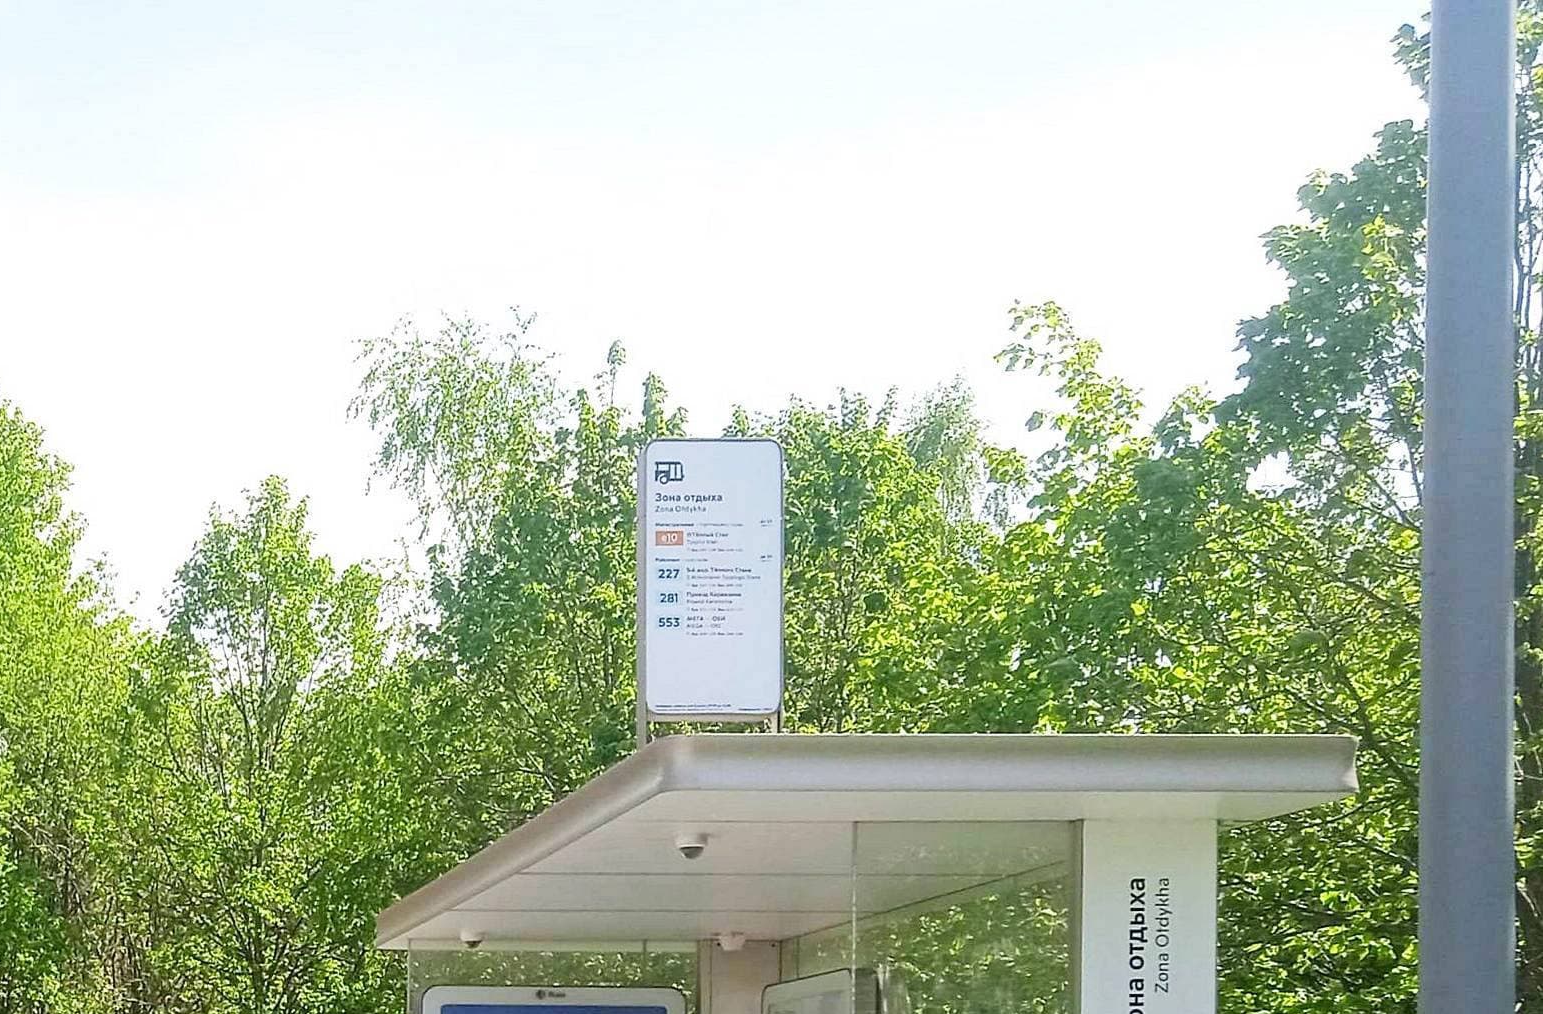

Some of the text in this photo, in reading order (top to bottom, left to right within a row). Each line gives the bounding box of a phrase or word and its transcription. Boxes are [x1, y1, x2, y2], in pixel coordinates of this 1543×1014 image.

[655, 493, 723, 503] Зона отдыха
[658, 569, 680, 579] 227
[660, 593, 678, 603] 281
[658, 617, 680, 627] 553
[1129, 877, 1148, 970] отдыха
[1155, 877, 1173, 993] Zona Otdykha
